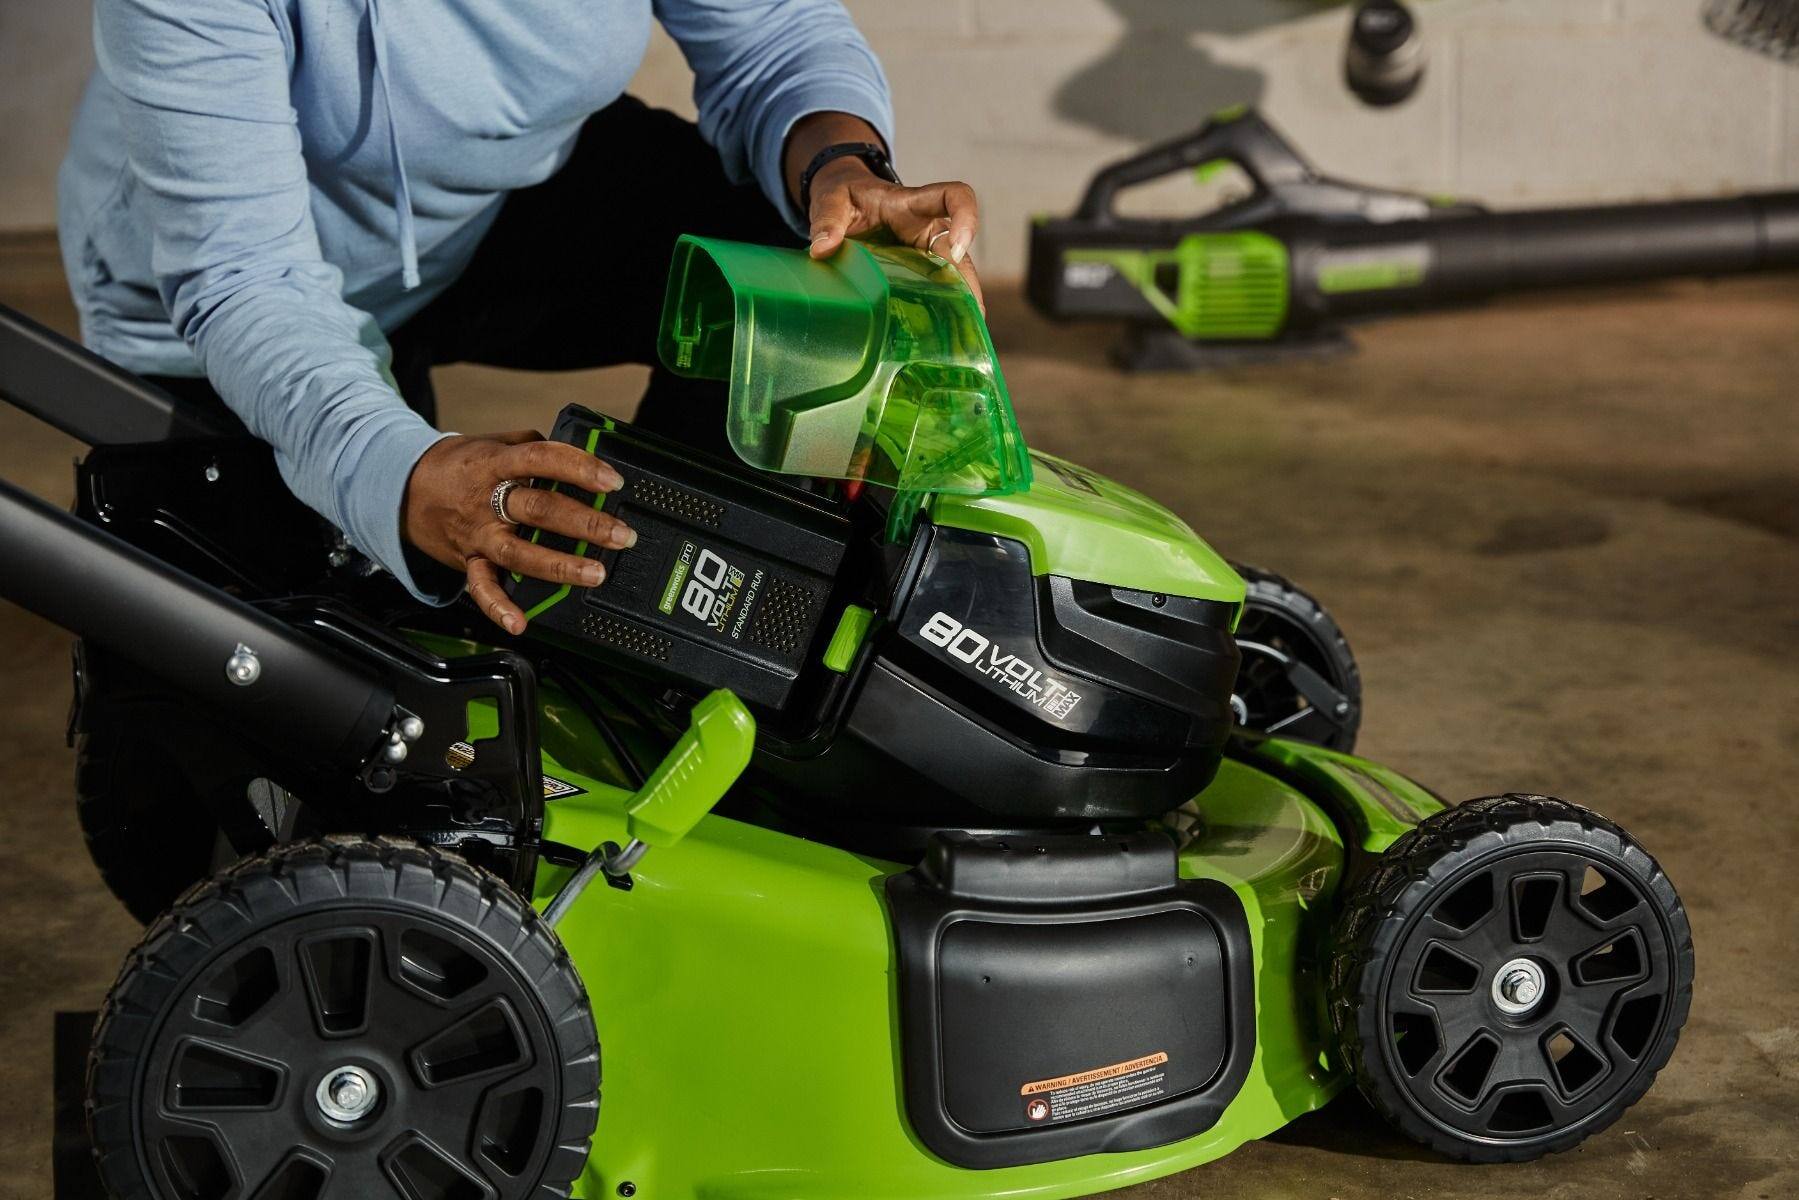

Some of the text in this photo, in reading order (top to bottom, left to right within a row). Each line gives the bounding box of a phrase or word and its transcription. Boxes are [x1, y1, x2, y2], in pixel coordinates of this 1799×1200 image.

[663, 543, 694, 610] greenworks pro
[681, 548, 728, 621] 80
[707, 575, 733, 627] VOLT
[732, 569, 764, 639] STANDARD RUN
[919, 611, 990, 664] 80
[975, 659, 1047, 707] LITHIUM
[990, 644, 1067, 697] VOLT
[1053, 692, 1080, 718] MAX
[1035, 1080, 1067, 1091] WARNING
[1072, 1068, 1120, 1084] AVERTISSEMENT
[1124, 1055, 1163, 1071] ADVERTENCIA
